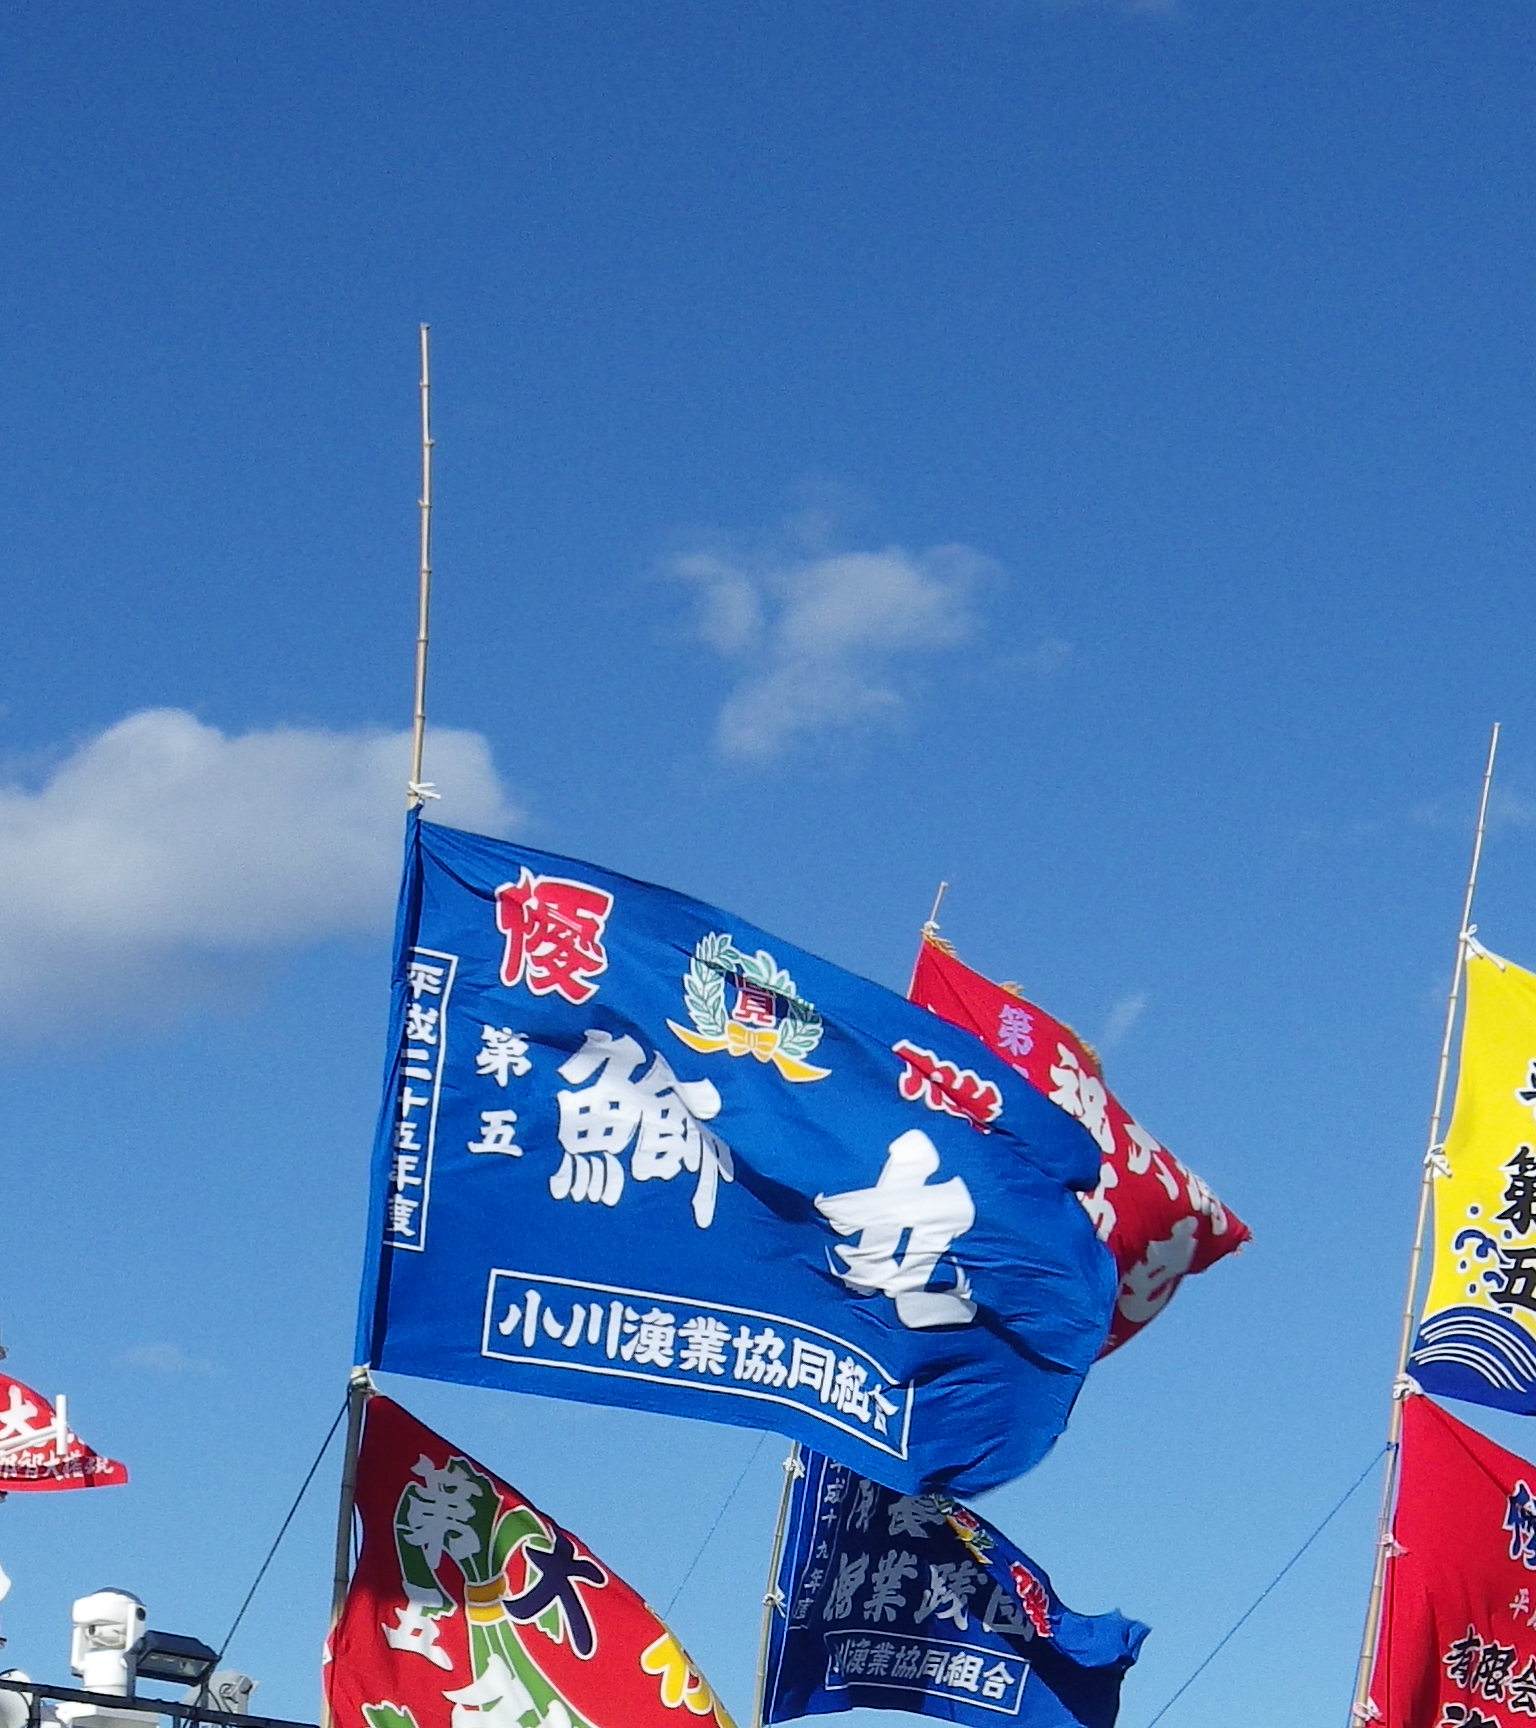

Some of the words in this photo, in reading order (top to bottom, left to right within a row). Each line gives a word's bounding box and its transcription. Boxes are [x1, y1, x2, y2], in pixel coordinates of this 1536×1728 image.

[492, 866, 615, 1005] 優
[467, 1022, 533, 1159] 第五
[497, 1288, 905, 1438] 小川漁業協同組合
